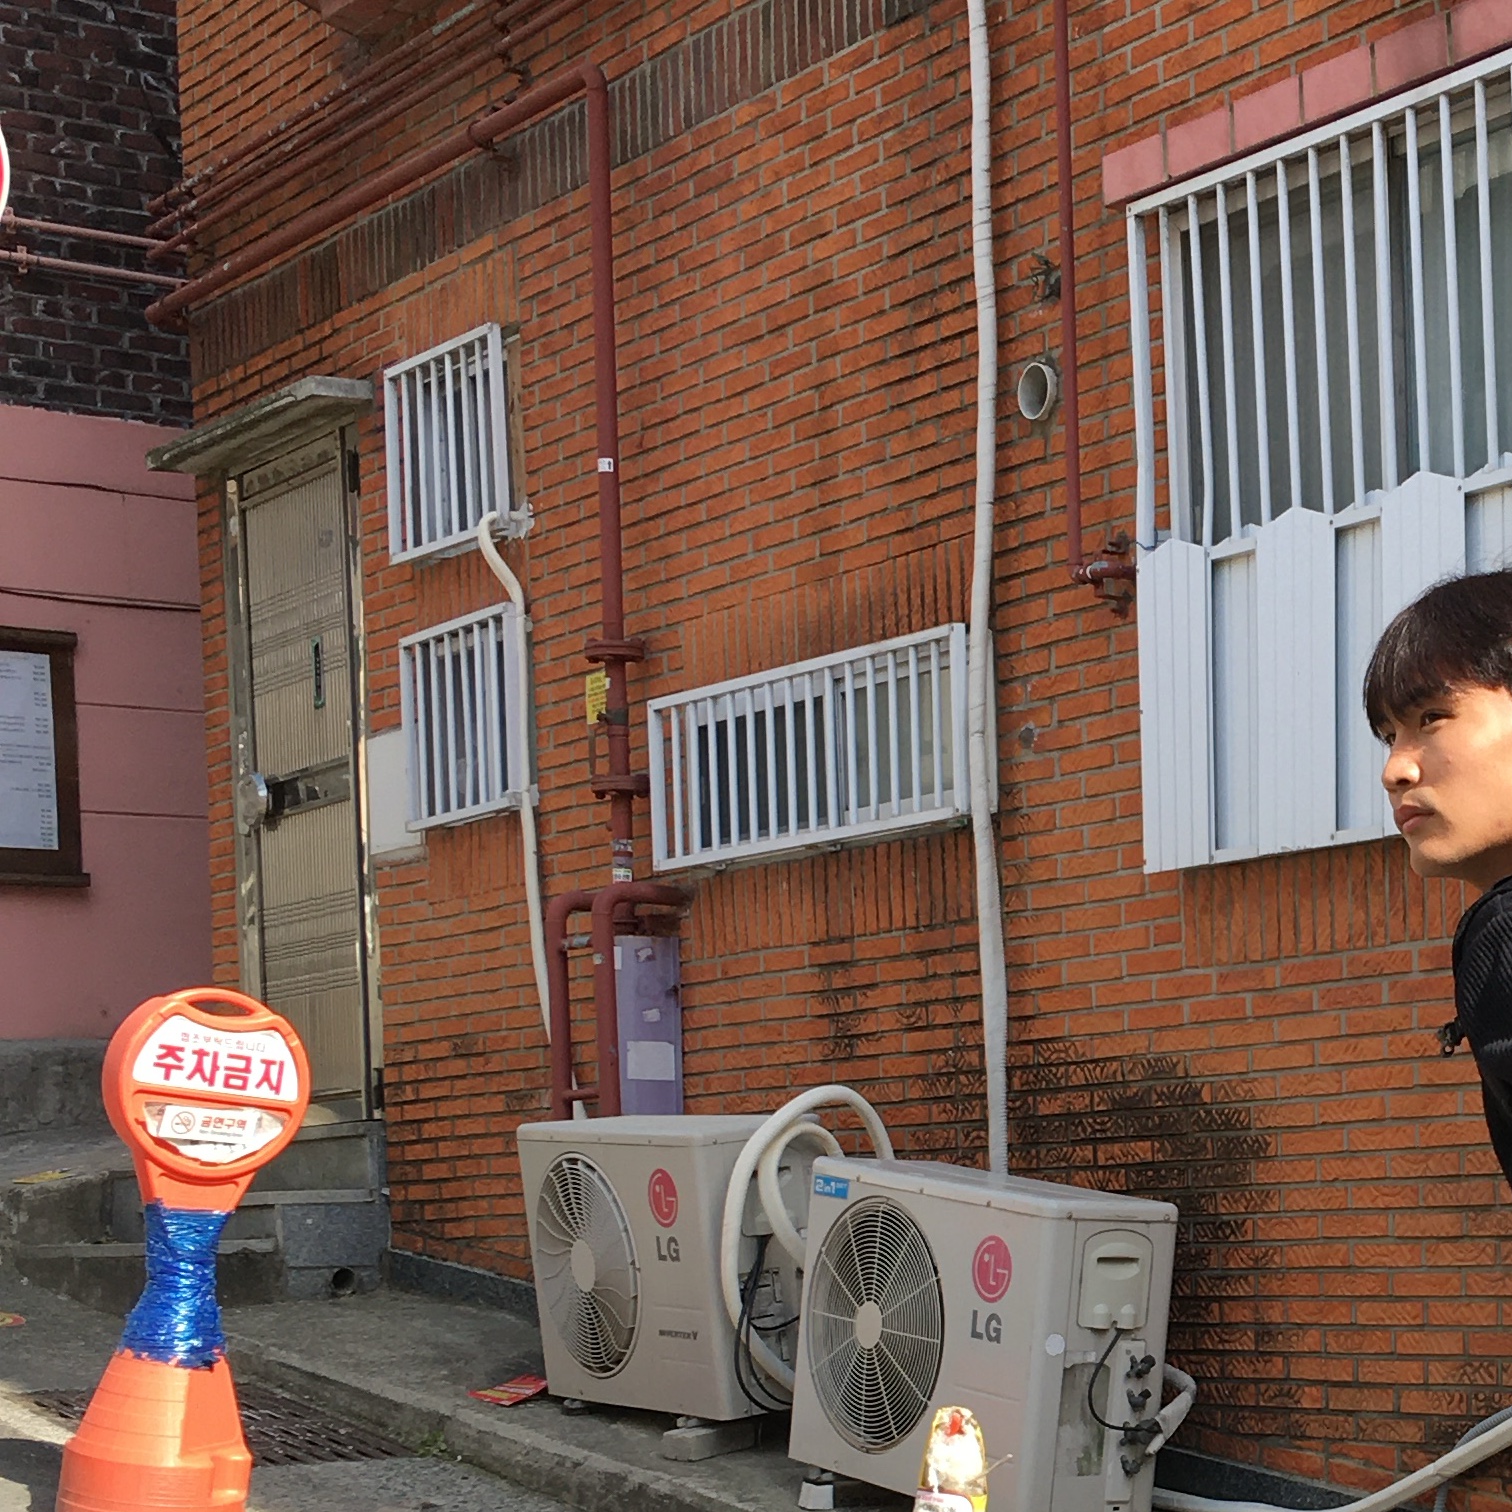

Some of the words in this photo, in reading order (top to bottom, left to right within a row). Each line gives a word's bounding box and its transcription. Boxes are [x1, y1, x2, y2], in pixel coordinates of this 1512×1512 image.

[153, 1044, 285, 1095] 주차금지
[201, 1116, 247, 1131] 금연구역
[656, 1235, 681, 1262] LG
[970, 1309, 1002, 1344] LG
